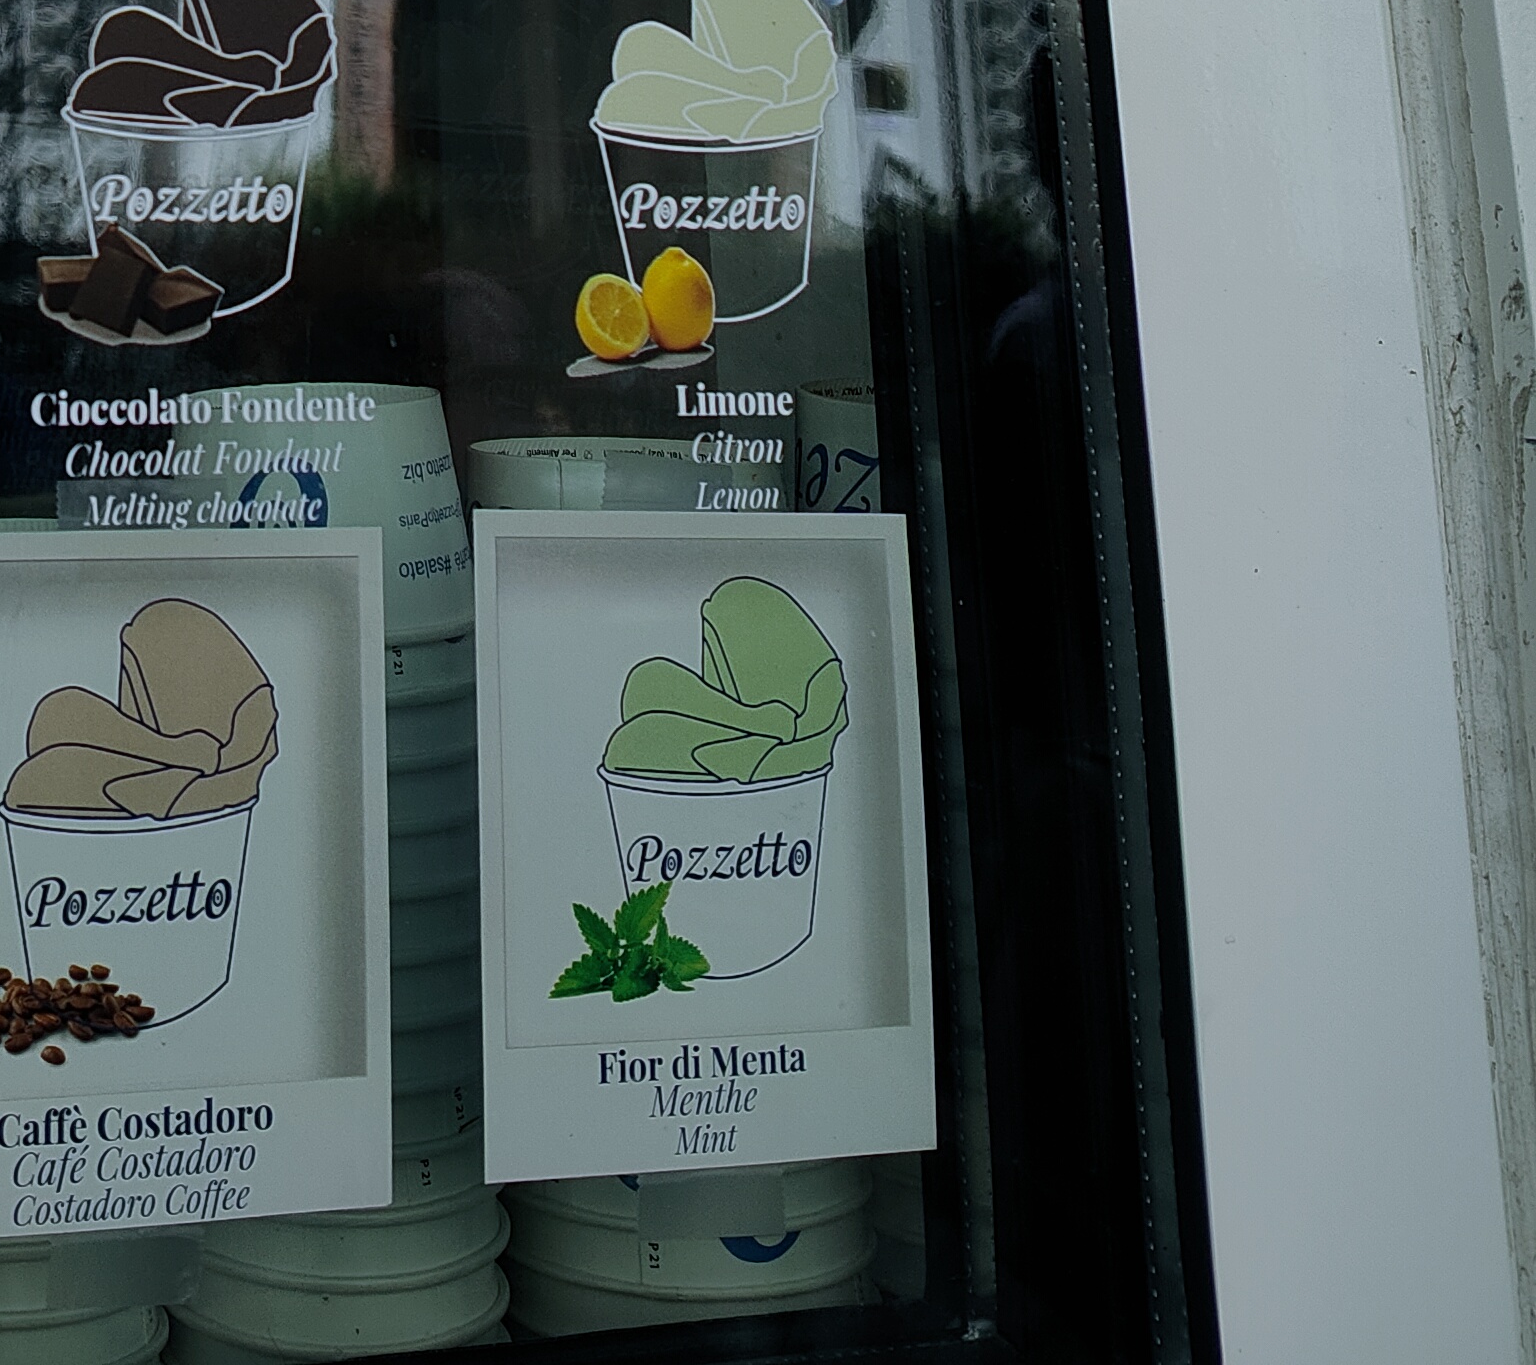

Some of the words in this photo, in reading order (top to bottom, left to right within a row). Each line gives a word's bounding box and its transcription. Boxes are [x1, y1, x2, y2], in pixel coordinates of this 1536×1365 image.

[91, 173, 296, 225] Pozzetto
[618, 182, 807, 232] Pozzetto
[30, 387, 213, 429] Cioccolato
[220, 390, 377, 425] Fondente
[675, 380, 795, 418] Limone
[64, 439, 207, 480] Chocolat
[211, 438, 346, 477] Fondant
[691, 429, 785, 466] Citron
[82, 491, 190, 532] Melting
[196, 489, 326, 526] chocolate
[694, 480, 782, 512] Lemon
[398, 553, 452, 580] #salato
[626, 830, 814, 885] Pozzetto
[23, 871, 233, 930] Pozzetto
[597, 1050, 665, 1086] Fior
[671, 1045, 703, 1081] di
[708, 1043, 808, 1077] Menta
[96, 1096, 275, 1144] Costadoro
[649, 1078, 758, 1120] Menthe
[675, 1122, 739, 1157] Mint
[12, 1147, 90, 1196] Café
[95, 1137, 258, 1183] Costadoro
[12, 1188, 157, 1227] Costadoro
[163, 1180, 251, 1221] Coffee
